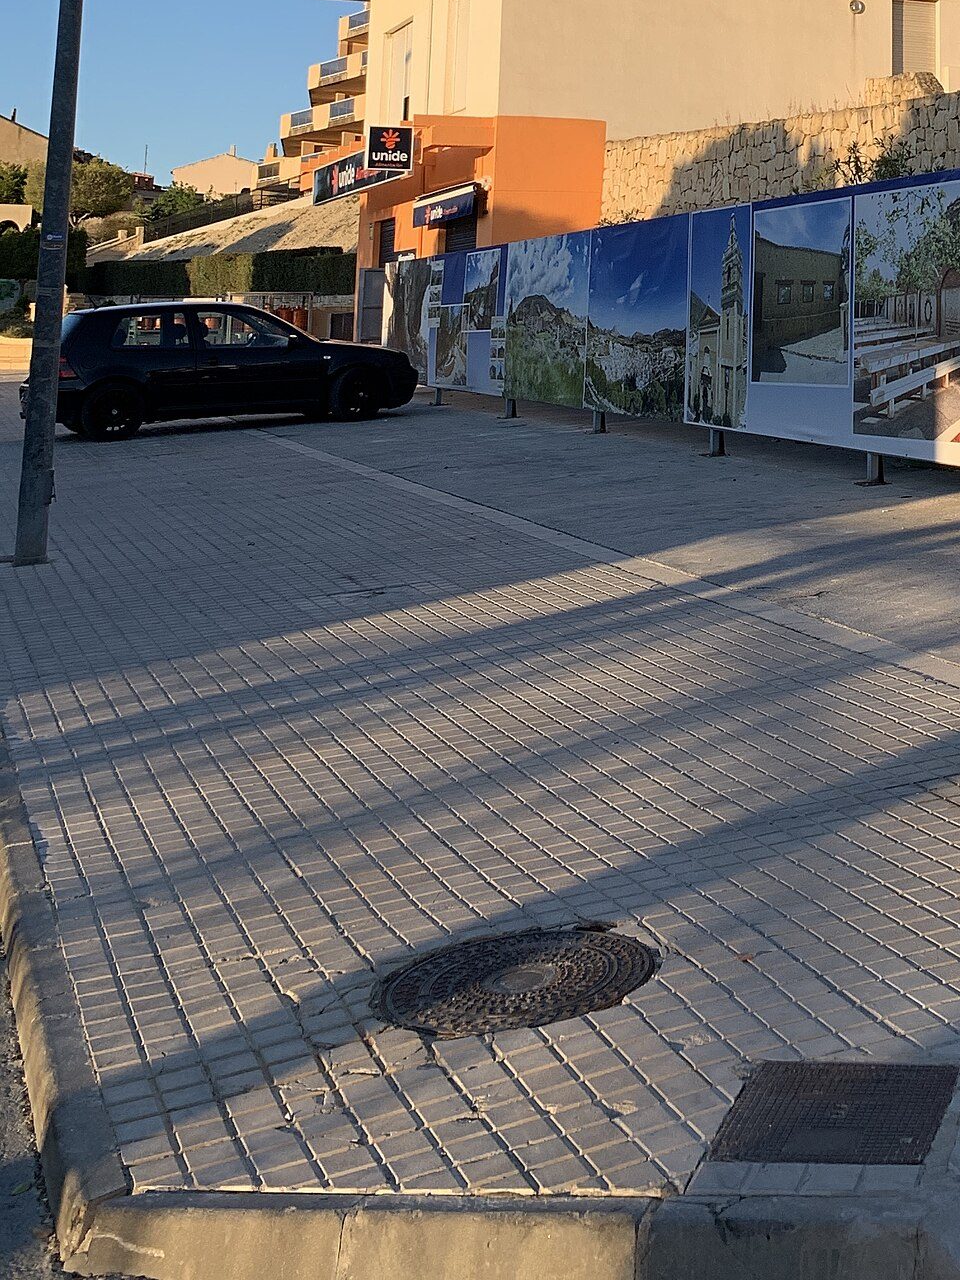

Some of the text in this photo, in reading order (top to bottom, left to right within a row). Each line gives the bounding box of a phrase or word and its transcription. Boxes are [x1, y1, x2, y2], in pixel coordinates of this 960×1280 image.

[372, 150, 408, 162] unide
[338, 163, 355, 188] unide
[430, 205, 443, 221] unide
